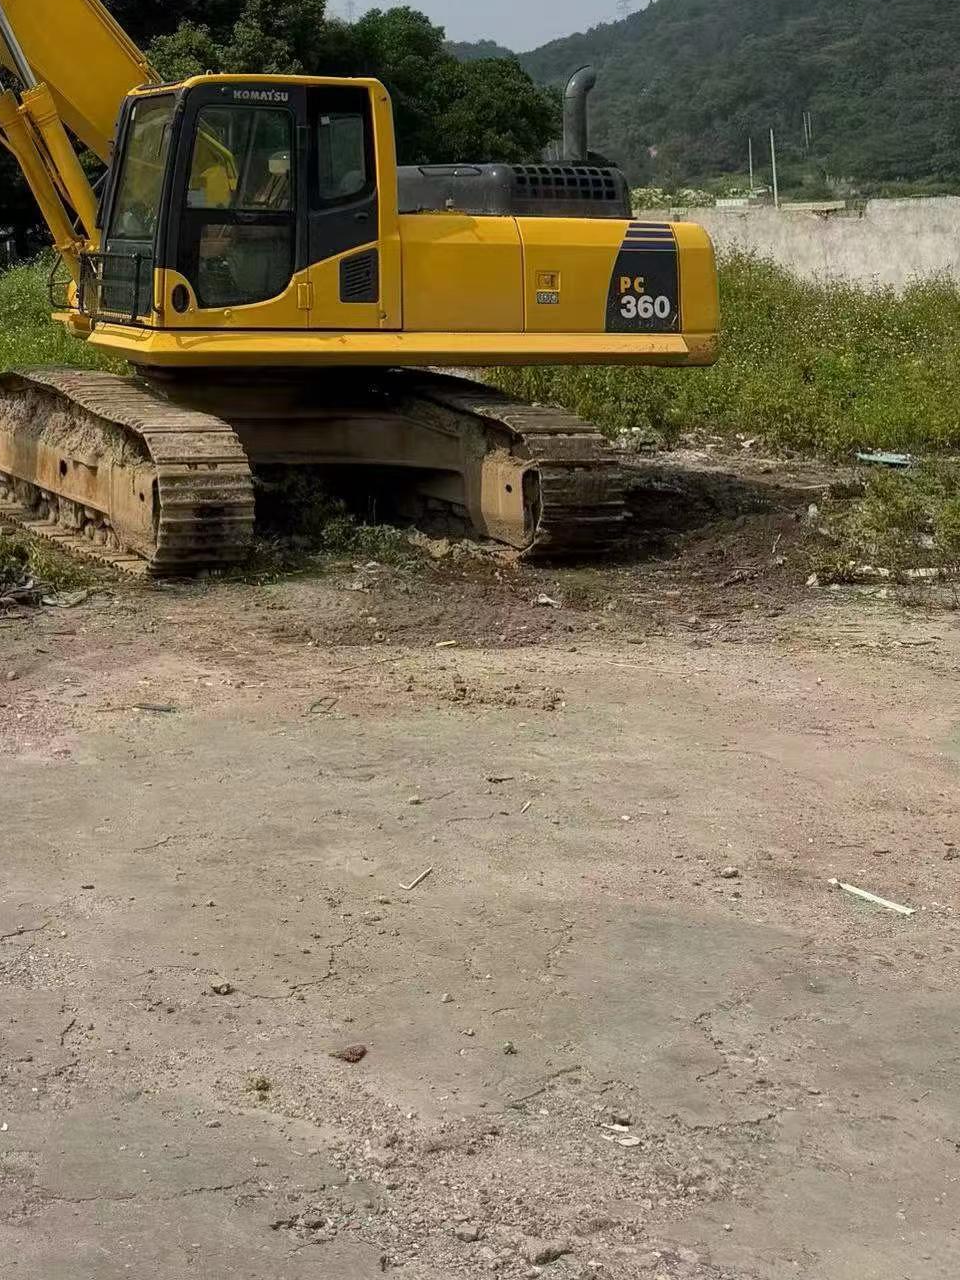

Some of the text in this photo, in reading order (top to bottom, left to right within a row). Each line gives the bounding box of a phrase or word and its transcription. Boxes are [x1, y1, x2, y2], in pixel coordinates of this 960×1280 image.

[233, 89, 289, 101] KOMATSU
[620, 276, 644, 293] PC
[620, 295, 671, 318] 360
